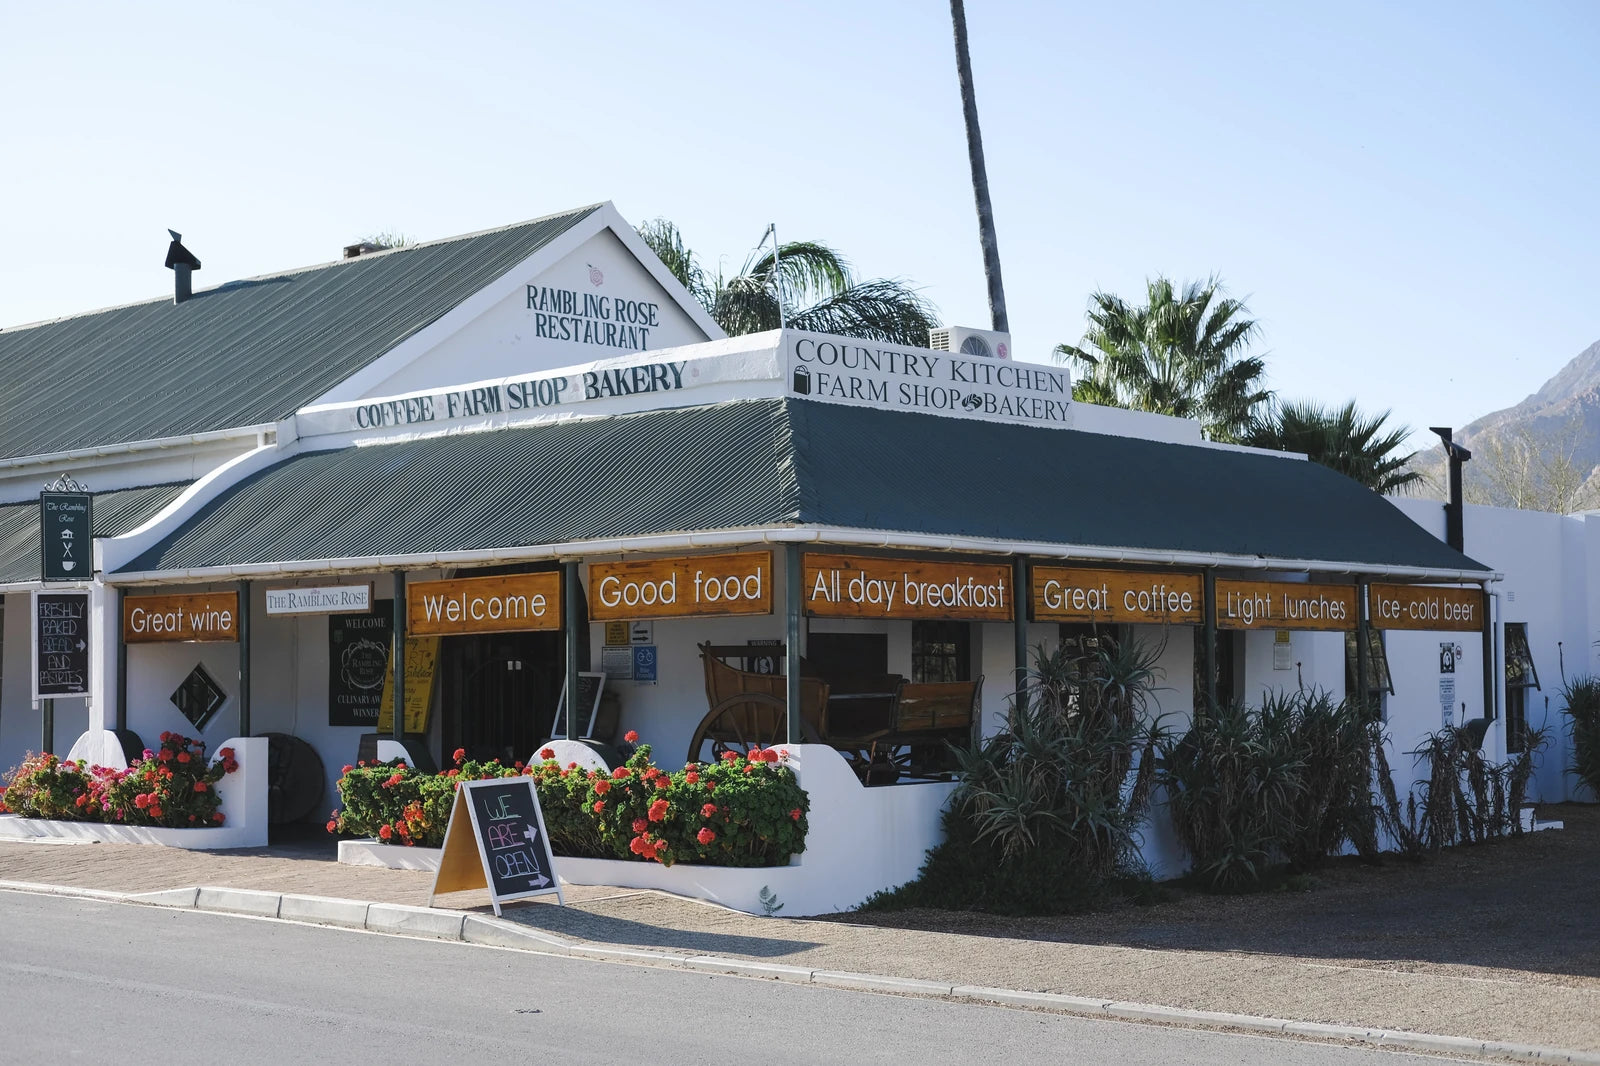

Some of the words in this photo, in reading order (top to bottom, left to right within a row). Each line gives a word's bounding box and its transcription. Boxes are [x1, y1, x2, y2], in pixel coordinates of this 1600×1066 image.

[526, 284, 610, 320] RAMBLING
[614, 298, 659, 327] ROSE
[535, 313, 650, 351] RESTAURANT
[795, 339, 939, 378] COUNTRY
[951, 361, 1064, 394] KITCHEN
[356, 395, 435, 428] COFFEE
[446, 386, 501, 418] FARM
[508, 376, 568, 410] SHOP
[583, 361, 688, 400] BAKERY
[816, 372, 889, 403] FARM
[899, 382, 961, 410] SHOP
[983, 392, 1071, 422] BAKERY
[46, 502, 58, 511] The
[59, 503, 87, 514] Rambling
[268, 594, 287, 609] THE
[288, 591, 339, 609] RAMBLING
[341, 591, 368, 606] ROSE
[599, 572, 676, 608] Good
[693, 567, 762, 602] food
[810, 569, 841, 603] All
[847, 570, 896, 612] day
[903, 571, 1005, 609] breakfast
[1043, 579, 1108, 611] Great
[1123, 583, 1193, 613] coffee
[39, 602, 85, 617] FRESHLY
[131, 606, 183, 633] Great
[189, 604, 232, 631] wine
[423, 591, 546, 624] Welcome
[1227, 591, 1271, 625] Light
[1284, 593, 1346, 620] lunches
[1377, 594, 1439, 620] Ice-cold
[1443, 598, 1474, 622] beer
[42, 619, 77, 635] BAKED
[345, 617, 386, 629] WELCOME
[42, 637, 74, 652] BREAD
[48, 655, 71, 669] AND
[39, 669, 83, 685] PASTRIES
[337, 694, 370, 704] CULINARY
[483, 794, 513, 820] WE
[488, 822, 518, 850] ARE
[495, 847, 540, 878] OPEN
